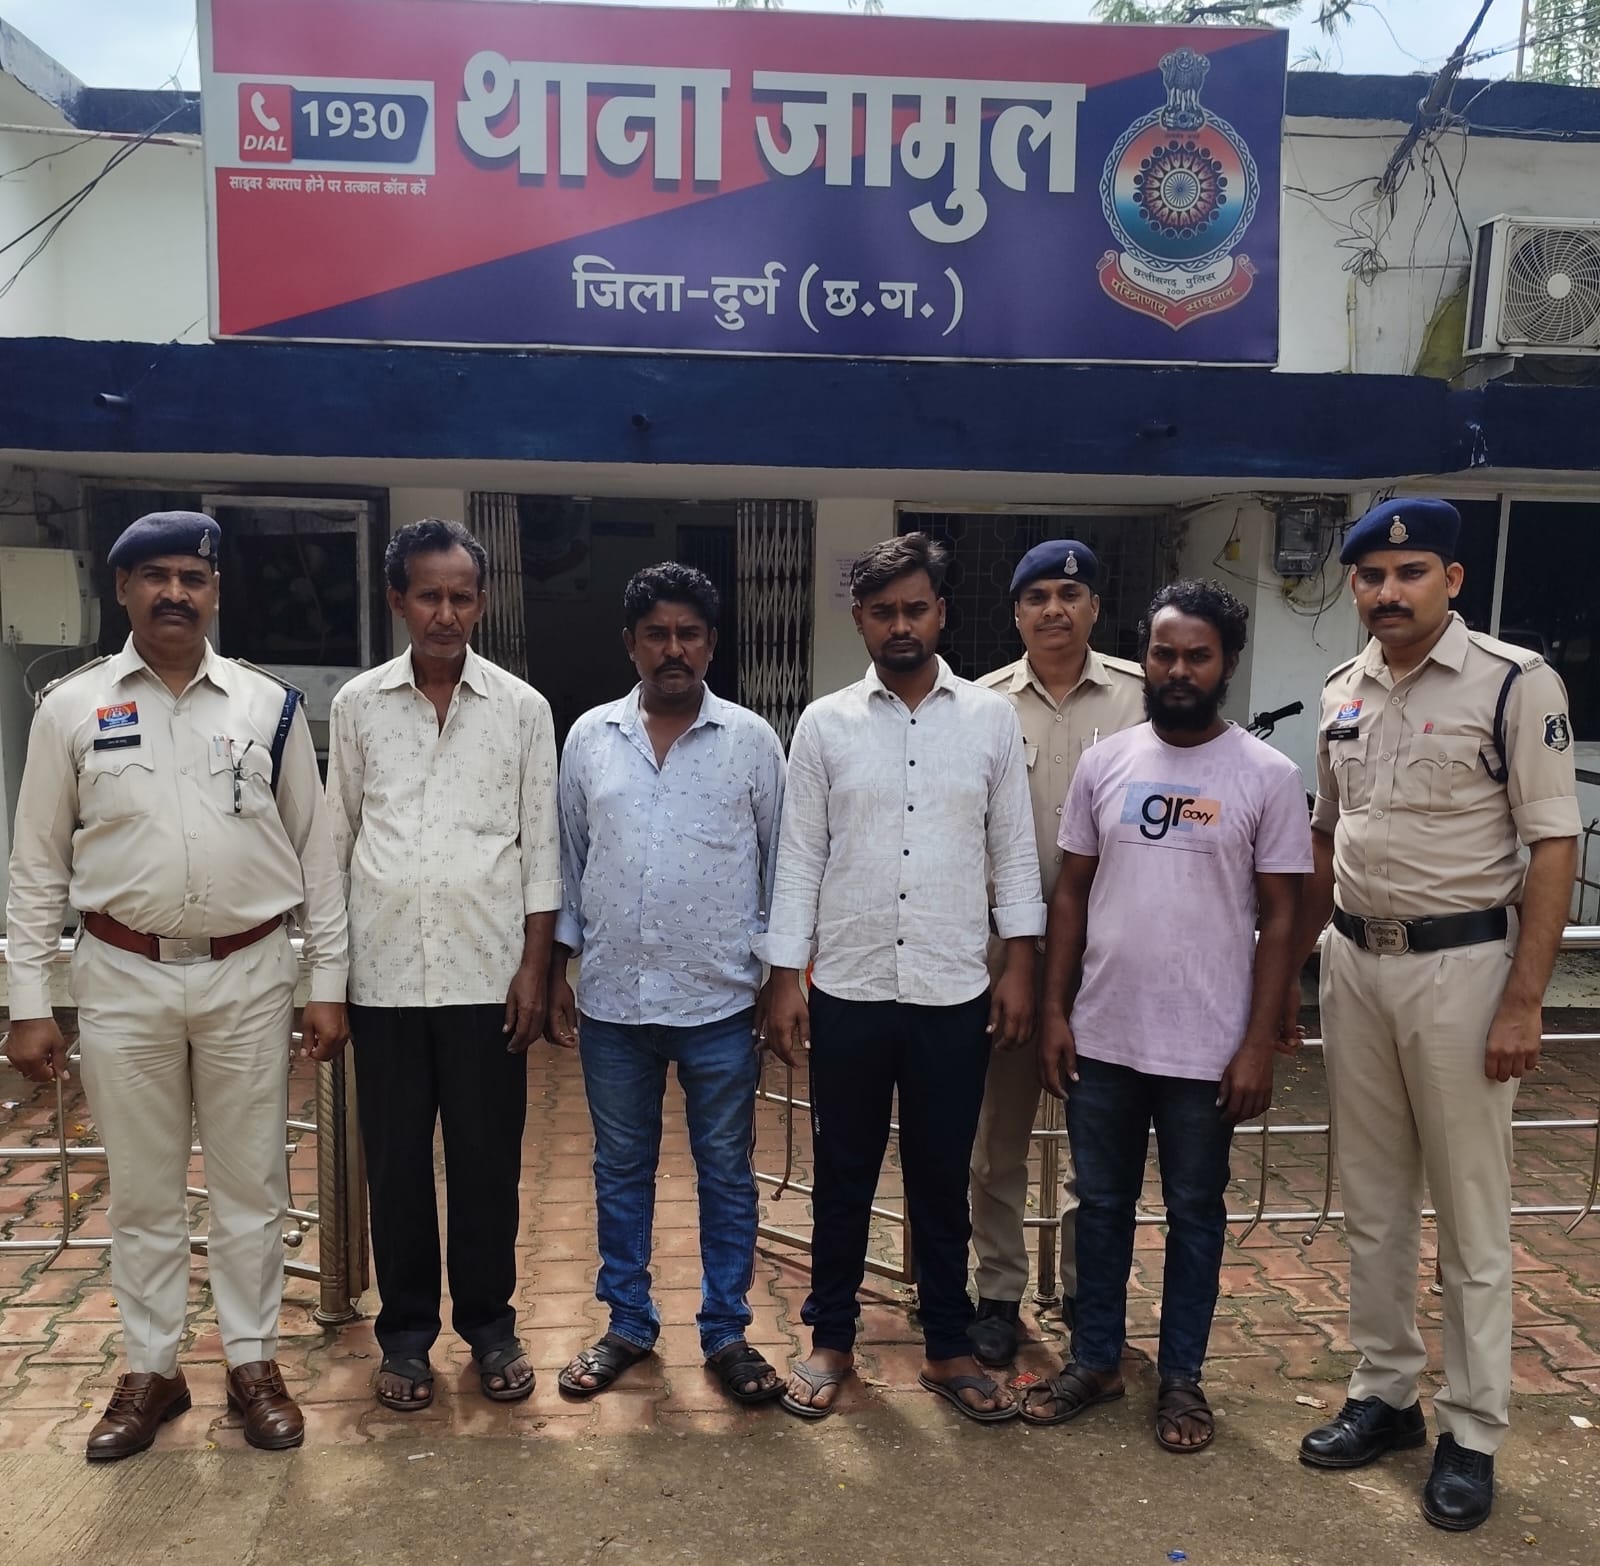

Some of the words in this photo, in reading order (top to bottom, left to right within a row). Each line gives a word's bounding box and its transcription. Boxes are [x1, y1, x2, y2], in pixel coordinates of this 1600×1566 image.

[301, 100, 406, 140] 1930
[243, 135, 287, 151] DIAL
[457, 50, 730, 182] थाना
[753, 71, 1086, 243] जामुल
[266, 177, 302, 192] अपराध
[305, 174, 325, 192] होने
[328, 179, 341, 192] पर
[344, 180, 380, 194] तत्काल
[384, 178, 407, 195] कॉल
[410, 178, 427, 196] करें
[572, 255, 787, 330] जिला-दुर्ग
[799, 263, 963, 337] (छ.ग.)
[1185, 271, 1217, 289] पुलिस
[1139, 794, 1214, 840] groovy
